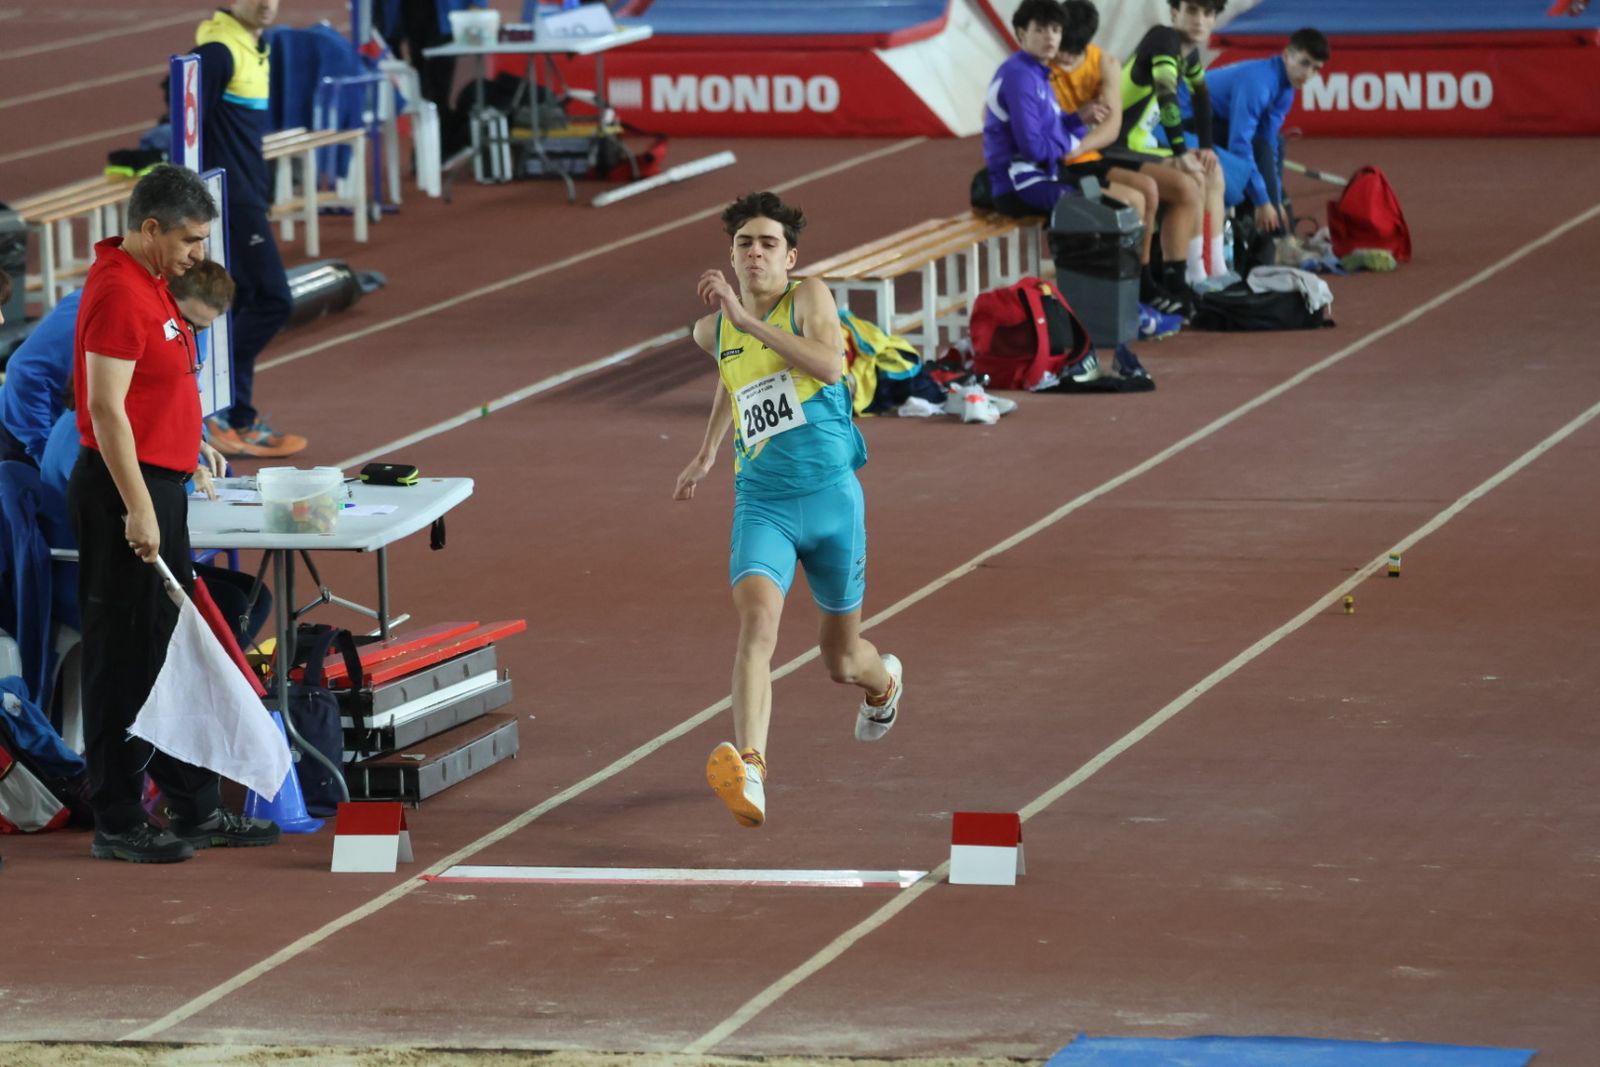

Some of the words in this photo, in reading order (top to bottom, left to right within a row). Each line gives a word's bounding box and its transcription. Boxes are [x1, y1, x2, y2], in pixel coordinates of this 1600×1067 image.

[651, 74, 841, 112] MONDO
[1302, 71, 1494, 111] MONDO
[744, 393, 794, 438] 2884
